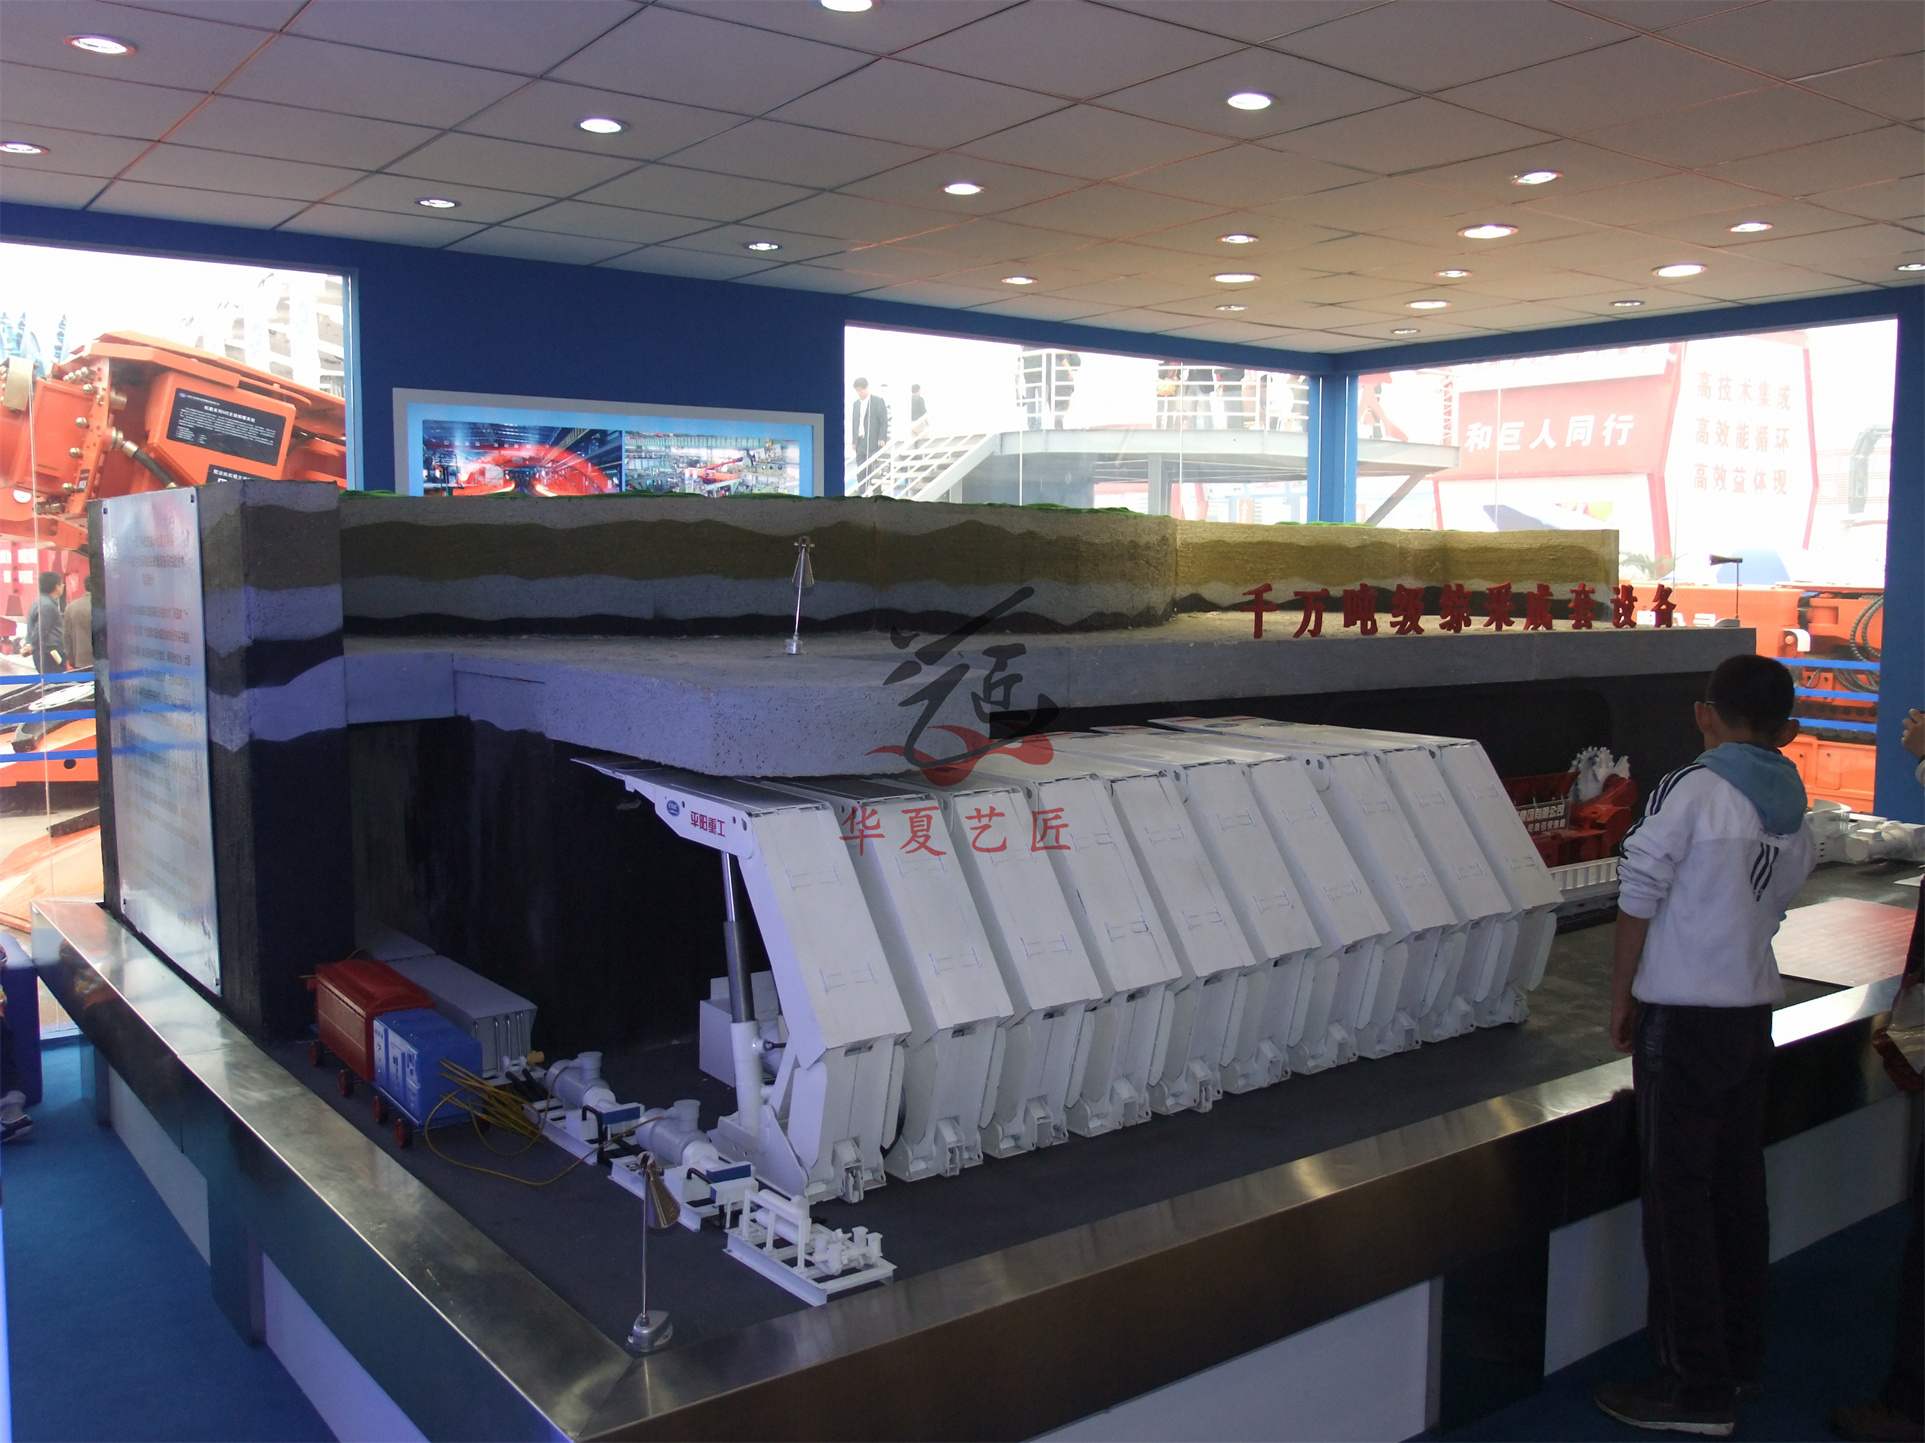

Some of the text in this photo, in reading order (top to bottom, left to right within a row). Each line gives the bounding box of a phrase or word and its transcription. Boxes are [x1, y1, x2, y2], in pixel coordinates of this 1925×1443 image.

[1698, 371, 1791, 411] 高技术集成
[1464, 413, 1634, 453] 和巨人同行
[1696, 417, 1790, 453] 高效能循环
[1694, 463, 1787, 495] 高效益体现
[1239, 583, 1676, 640] 千万吨级综采成套设备
[691, 811, 726, 837] 平阳重工
